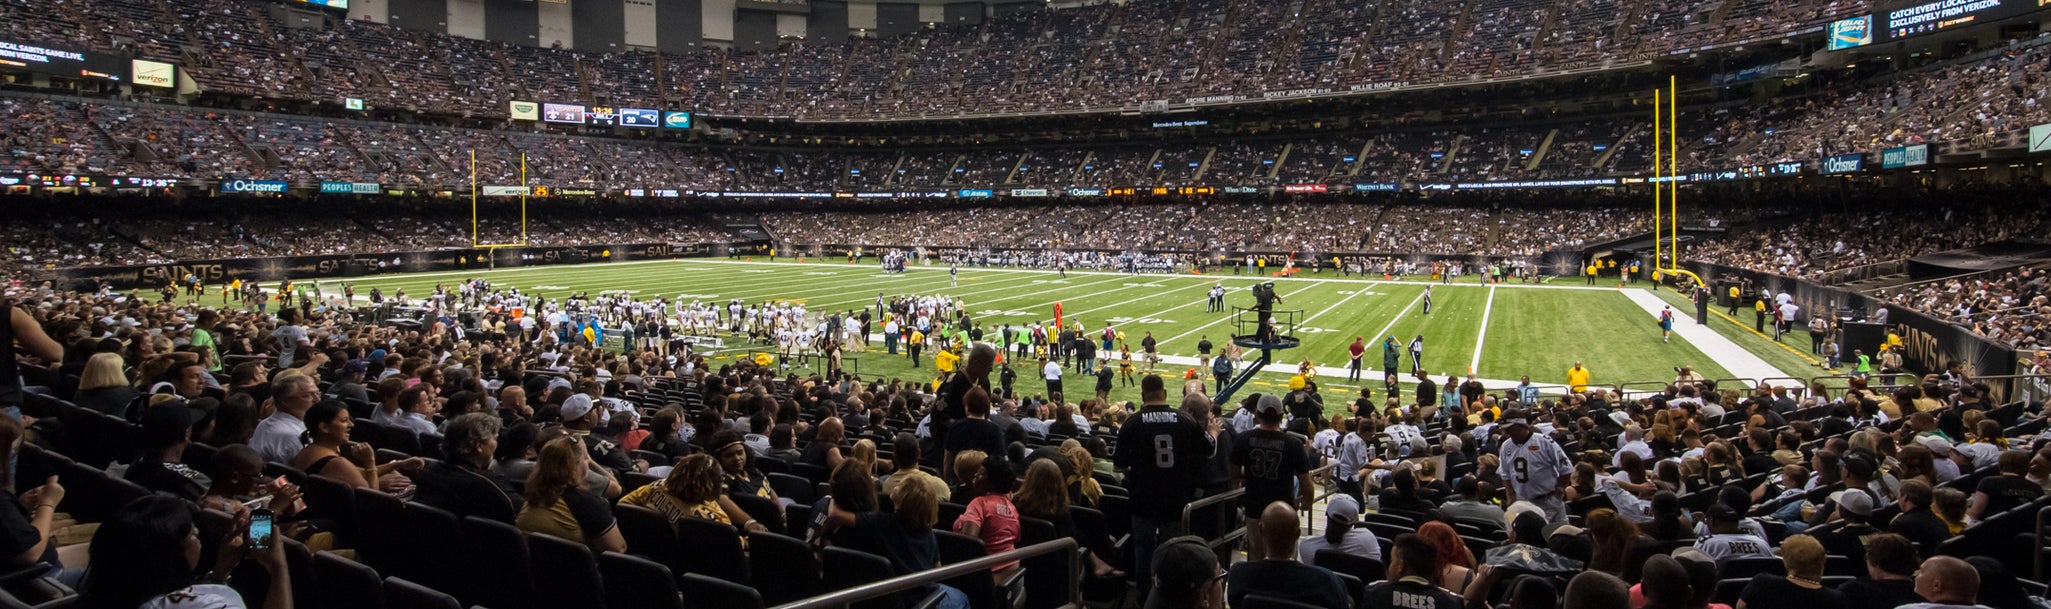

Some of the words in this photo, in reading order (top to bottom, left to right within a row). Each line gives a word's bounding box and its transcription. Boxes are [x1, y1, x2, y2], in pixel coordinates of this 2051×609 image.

[1890, 7, 1914, 19] CATCH
[1915, 3, 1941, 15] EVERY
[1942, 0, 1967, 10] LOCAL
[1890, 12, 1941, 28] EXCLUSIVELY
[1942, 7, 1964, 18] FROM
[0, 41, 18, 51] OCAL
[18, 44, 45, 55] SAINTS
[45, 48, 66, 58] GAME
[0, 49, 16, 58] ROM
[137, 74, 169, 84] verizon
[1287, 88, 1316, 96] JACKSON
[626, 116, 637, 124] 20
[1884, 151, 1905, 165] PEOPLES
[1828, 157, 1859, 173] Ochsner
[233, 180, 283, 192] Ochsner
[322, 183, 351, 191] PEOPLES
[536, 187, 547, 196] 25
[1072, 188, 1100, 196] Ochsner
[1142, 411, 1178, 423] MANNING
[1398, 431, 1408, 444] 9
[593, 439, 616, 456] 73
[1154, 434, 1174, 468] 8
[1249, 448, 1283, 480] 37
[1513, 456, 1529, 484] 9
[650, 489, 684, 524] COLSTO
[1728, 541, 1760, 554] BREES
[1392, 590, 1436, 609] BREES
